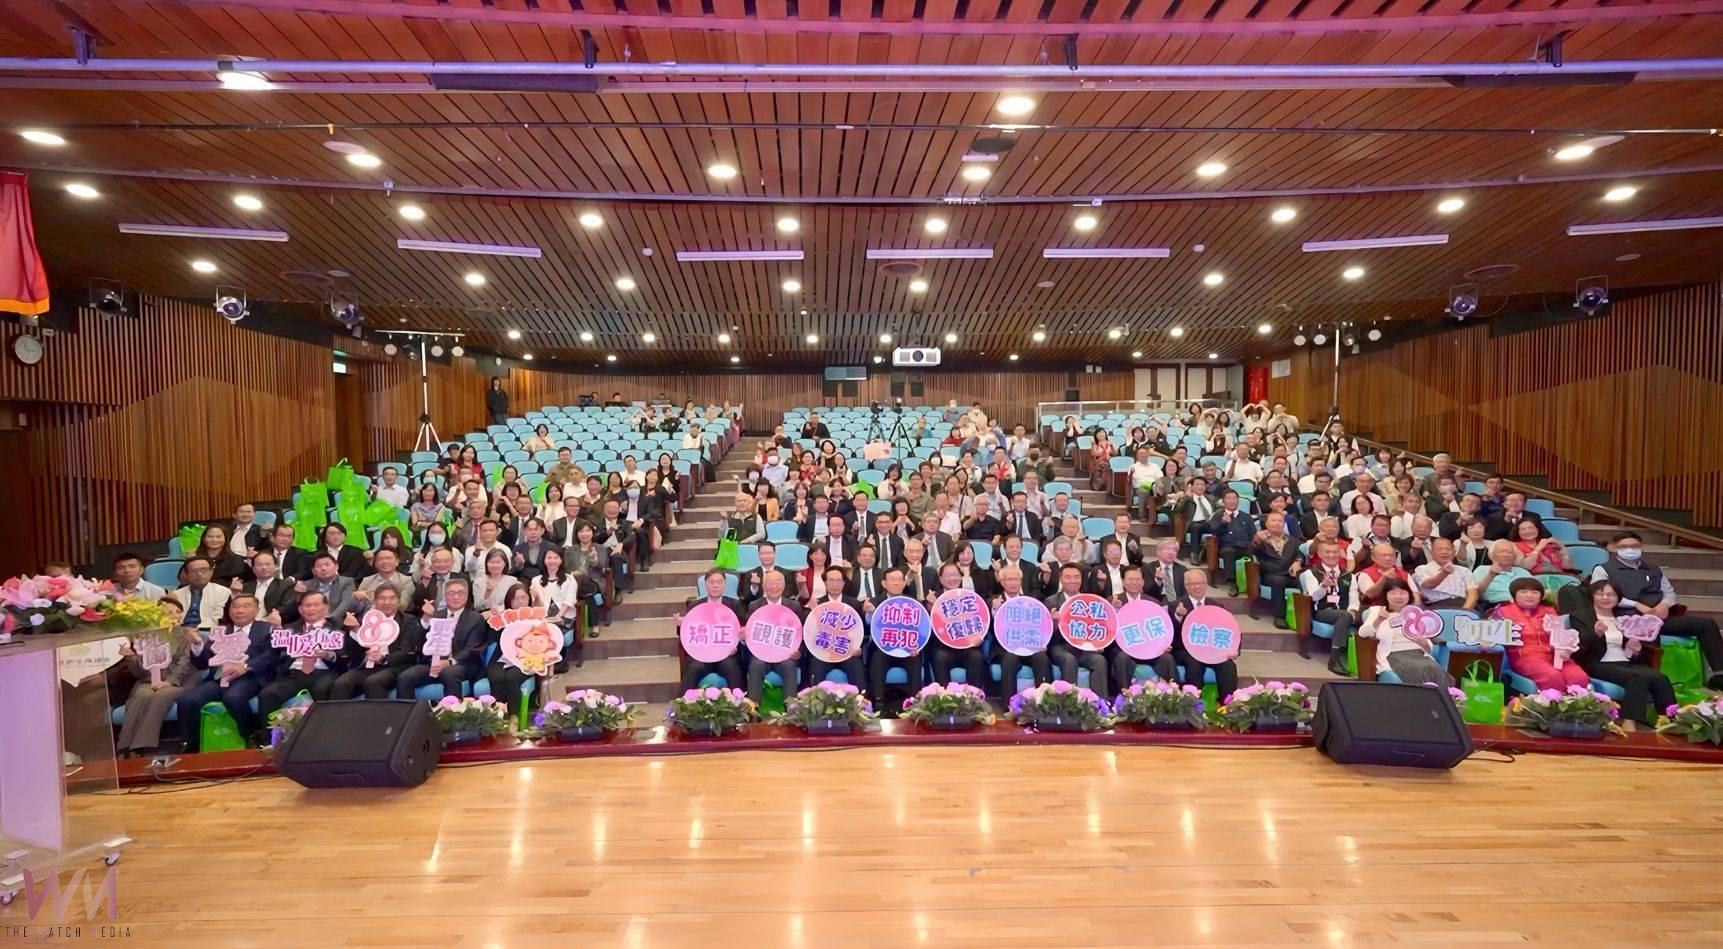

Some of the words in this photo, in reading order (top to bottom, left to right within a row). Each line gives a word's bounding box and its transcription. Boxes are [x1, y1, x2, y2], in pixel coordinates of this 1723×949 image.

[883, 603, 919, 625] 抑制
[942, 596, 977, 617] 穩定
[1006, 606, 1043, 624] 阻絕
[1071, 601, 1107, 619] 公私
[821, 611, 857, 630] 減少
[947, 616, 982, 639] 復歸
[689, 625, 731, 644] 矯正
[752, 622, 794, 648] 觀護
[882, 629, 917, 649] 再犯
[1005, 628, 1041, 649] 供需
[1070, 622, 1106, 641] 協力
[1121, 617, 1163, 646] 更保
[1189, 624, 1232, 648] 檢察
[816, 631, 851, 654] 毒害
